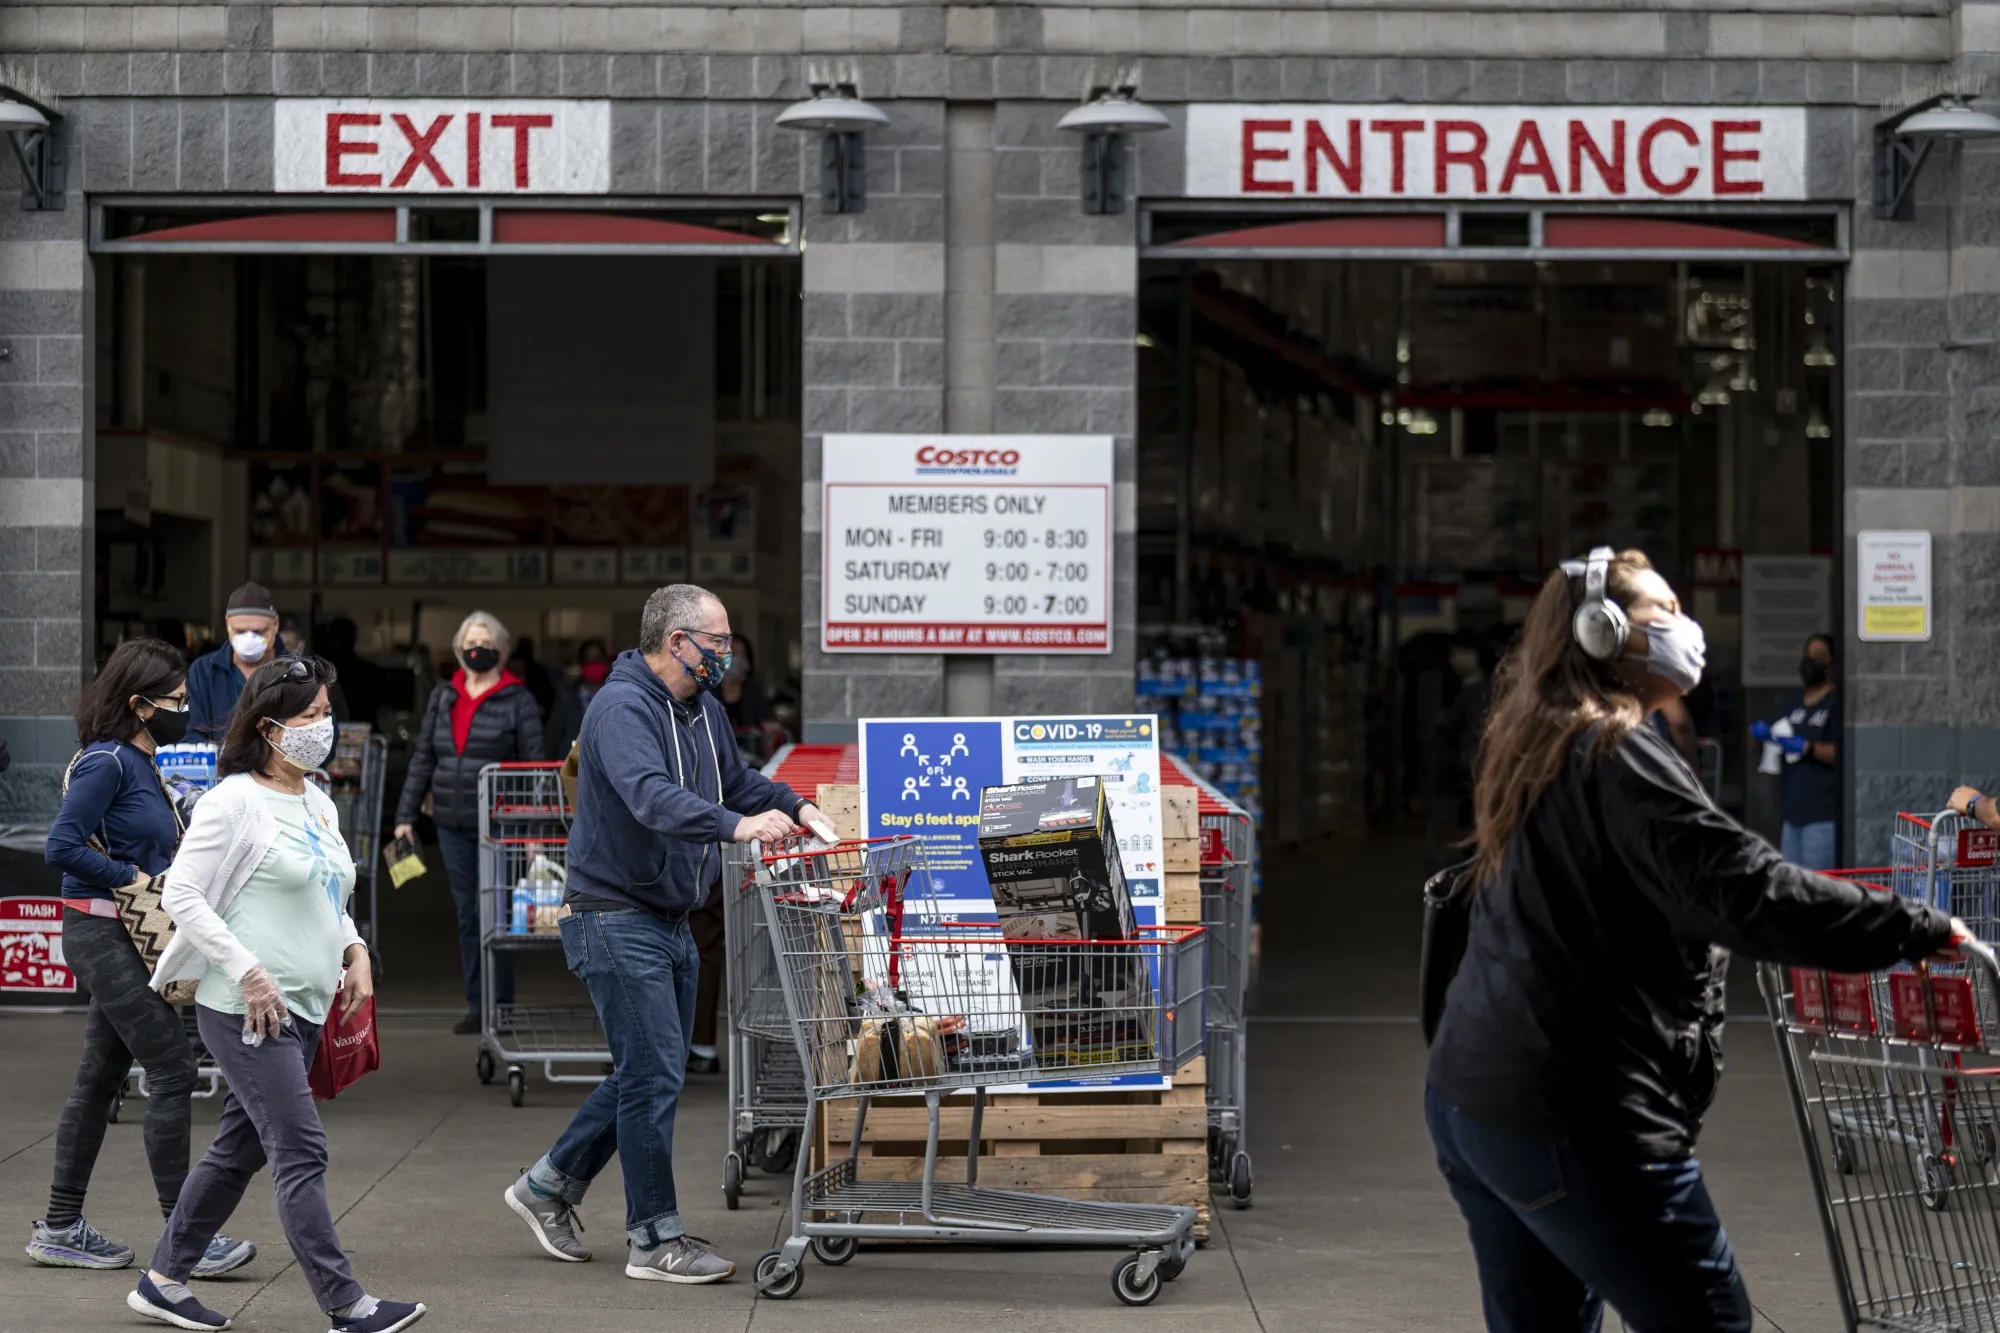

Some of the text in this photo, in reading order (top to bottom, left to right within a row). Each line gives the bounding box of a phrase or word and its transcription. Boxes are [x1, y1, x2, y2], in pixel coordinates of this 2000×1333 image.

[325, 112, 553, 188] EXIT
[1240, 117, 1764, 195] ENTRANCE
[889, 495, 1046, 514] MEMBERS ONLY
[845, 529, 892, 548] MON
[911, 529, 943, 548] FRI
[984, 529, 1026, 548] 9:00
[1045, 529, 1088, 548] 8:30
[1887, 552, 1901, 560] NO
[845, 561, 950, 581] SATURDAY
[985, 562, 1028, 582] 9:00
[1047, 562, 1088, 582] 7:00
[1875, 562, 1915, 571] ANIMALS
[1873, 573, 1916, 582] ALLOWED
[845, 595, 927, 614] SUNDAY
[984, 595, 1026, 615] 9:00
[1043, 595, 1088, 615] 7:00
[828, 627, 1106, 644] OPEN 24 HOURS A DAY AT WWW.COSTCO.COM
[1016, 723, 1102, 740] COVID-19
[881, 813, 912, 827] Stay
[914, 813, 924, 825] 6
[926, 813, 953, 825] feet
[955, 815, 980, 827] apa
[989, 848, 1079, 863] Shark Rocket
[1967, 851, 1991, 859] COSTCO
[992, 856, 1080, 872] PERFORMANCE
[18, 903, 57, 917] TRASH
